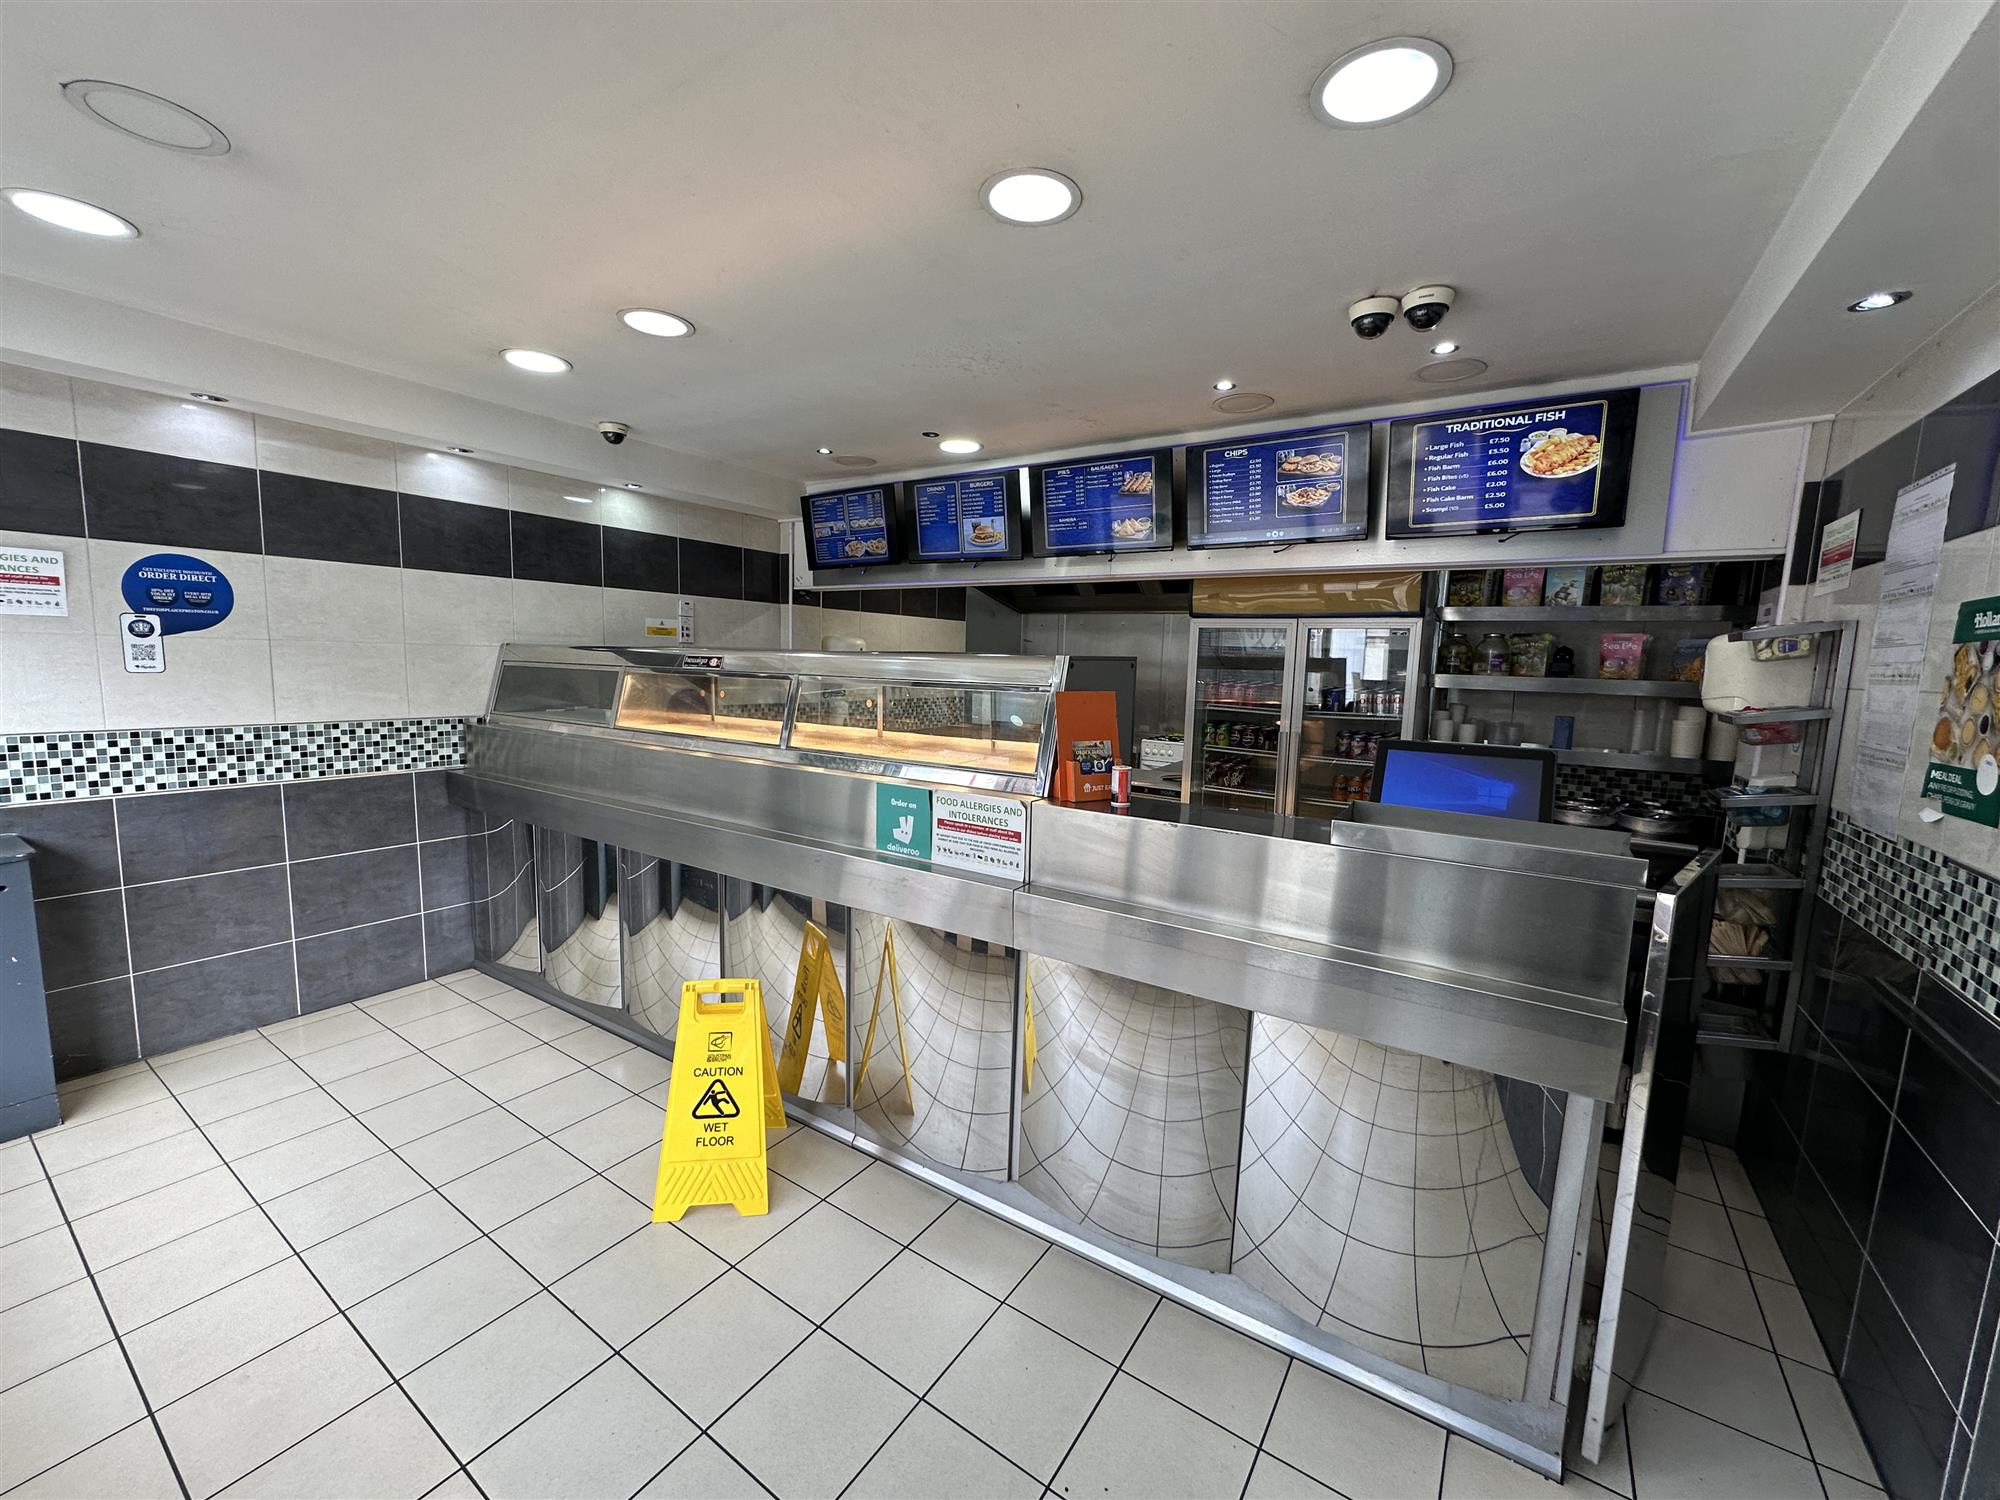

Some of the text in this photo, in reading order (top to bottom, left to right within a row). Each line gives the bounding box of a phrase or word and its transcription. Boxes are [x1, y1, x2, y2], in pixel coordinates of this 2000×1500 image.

[1446, 410, 1566, 433] TRADITIONAL FISH
[1224, 448, 1248, 458] CHIPS
[1428, 454, 1453, 462] Regular
[31, 556, 58, 564] AND
[139, 571, 217, 582] ORDER DIRECT
[1602, 642, 1638, 650] Sea Life
[891, 798, 908, 808] Order
[936, 796, 1022, 817] FOOD ALLERGIES AND
[949, 810, 1009, 827] INTOLERANCES
[887, 843, 920, 856] deliveroo
[693, 1066, 743, 1078] CAUTION
[704, 1122, 728, 1133] WET
[696, 1136, 734, 1148] FLOOR
